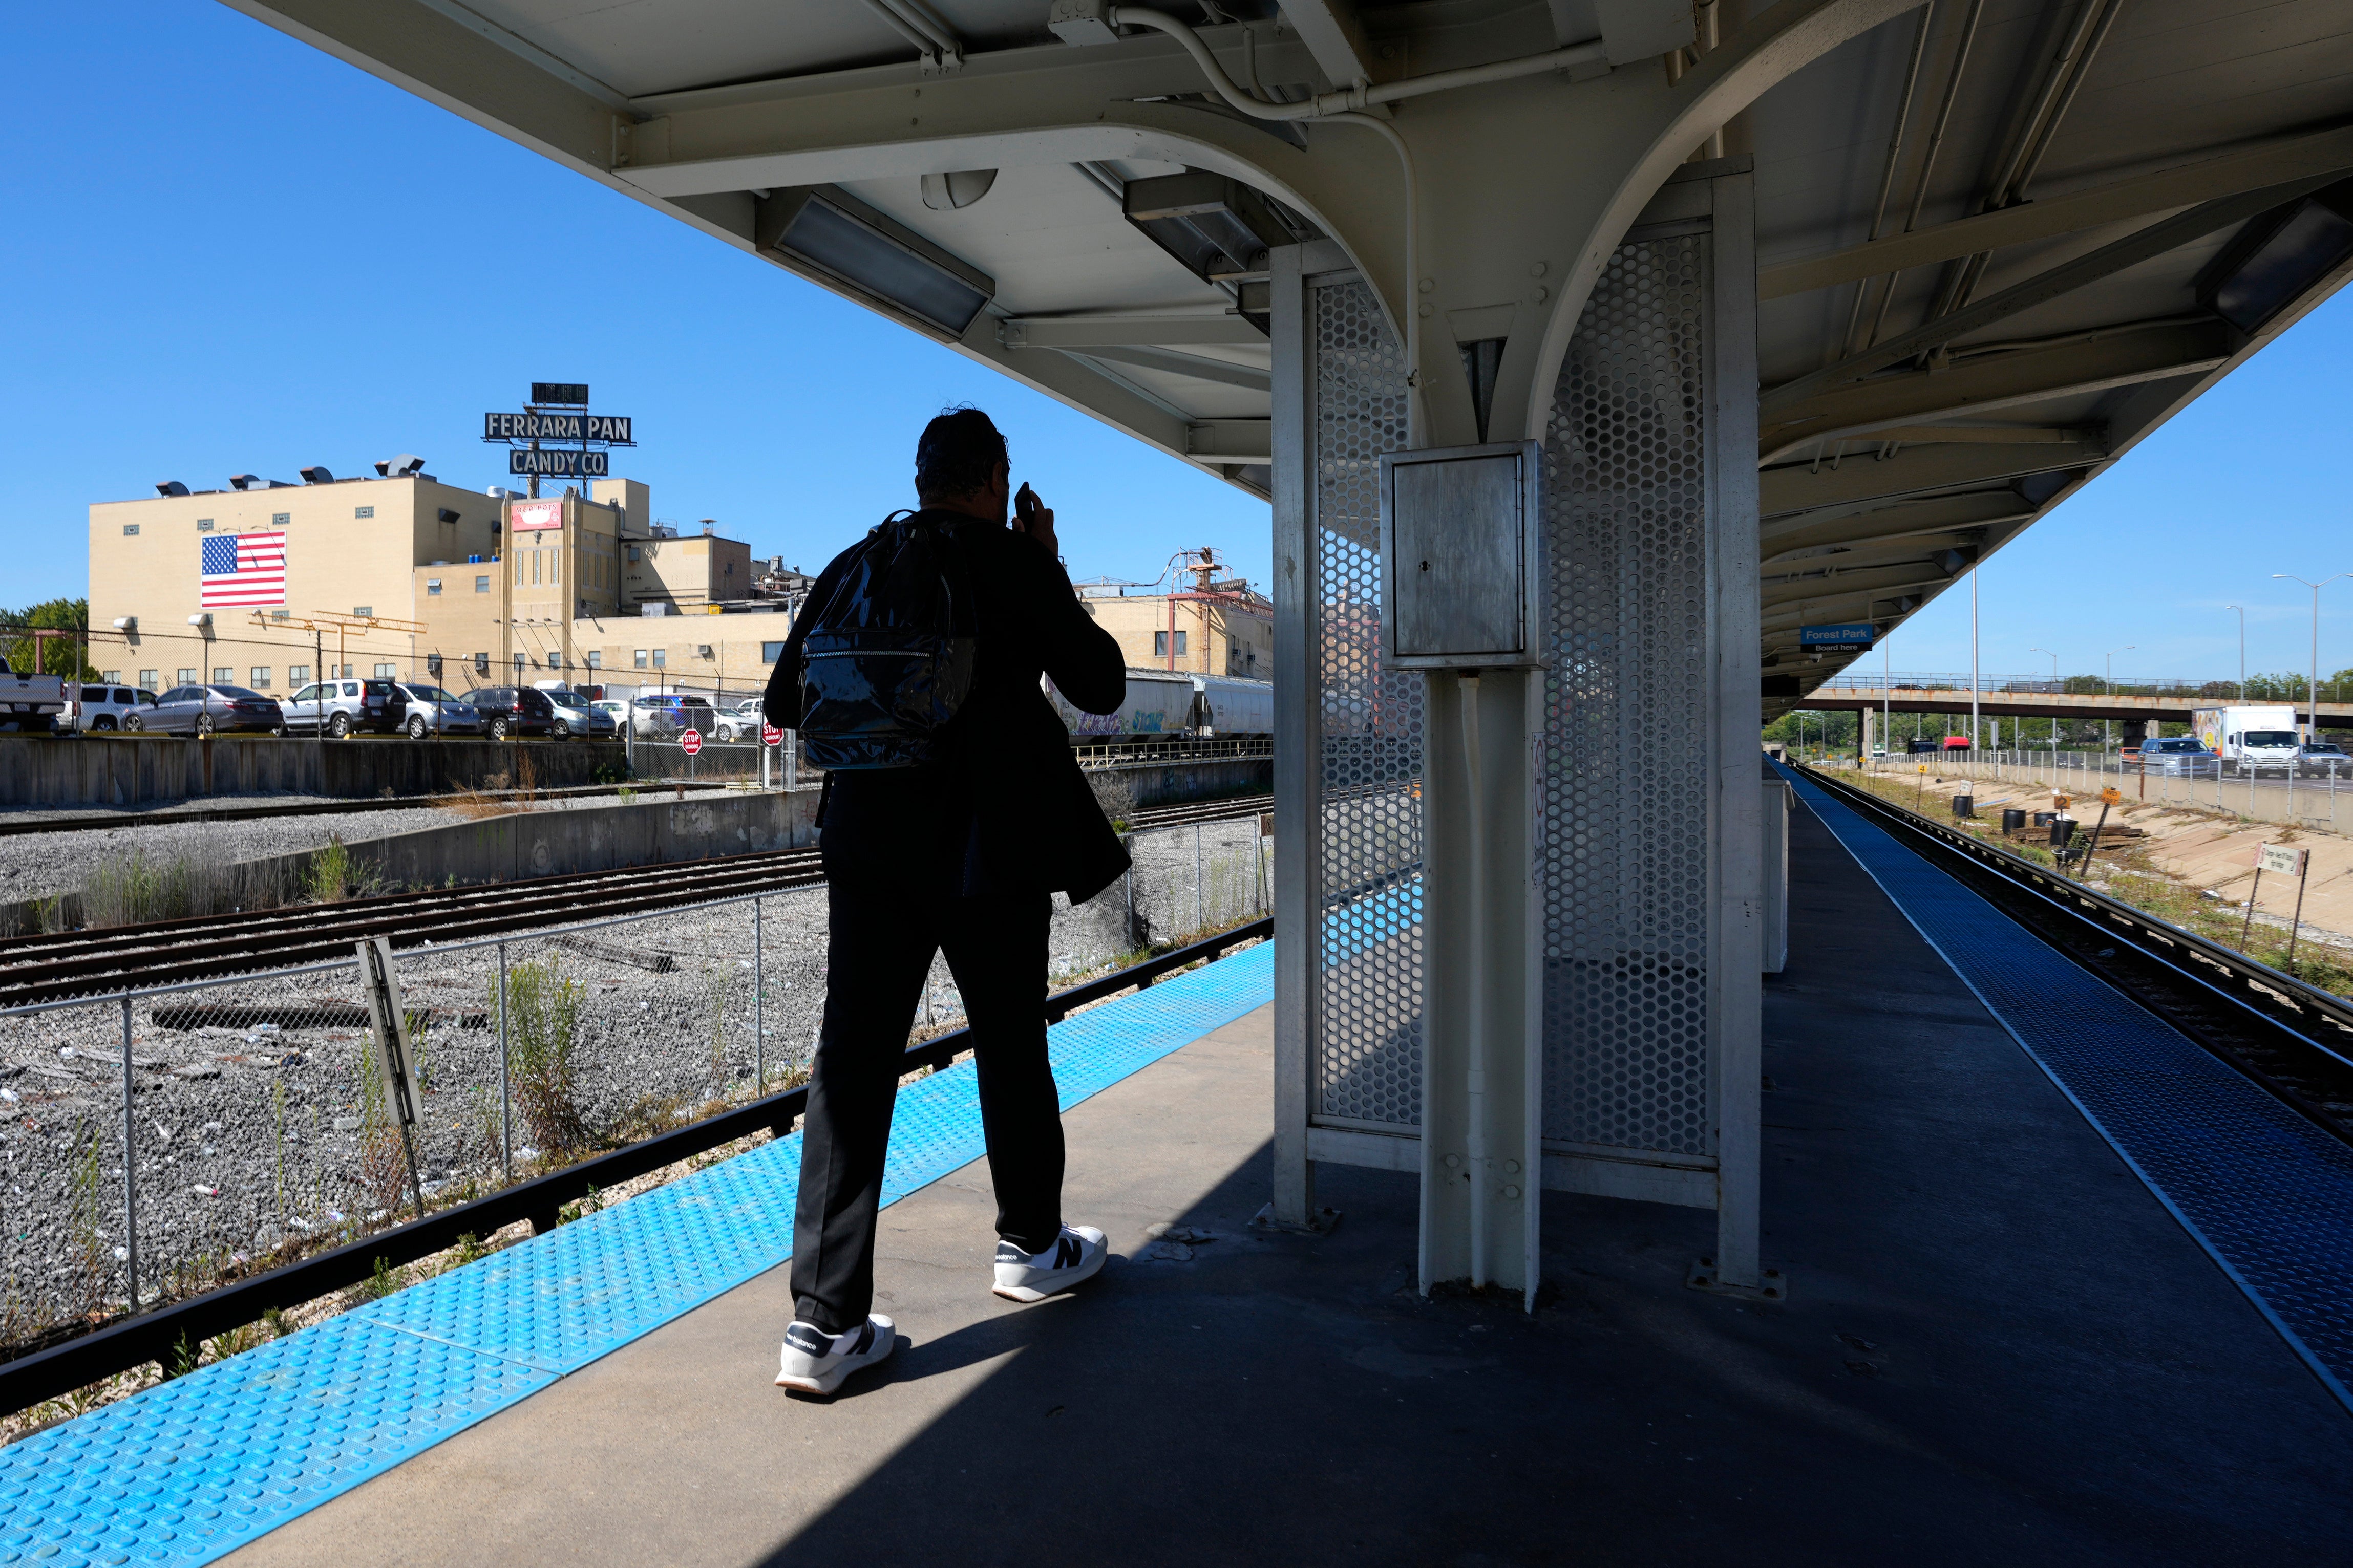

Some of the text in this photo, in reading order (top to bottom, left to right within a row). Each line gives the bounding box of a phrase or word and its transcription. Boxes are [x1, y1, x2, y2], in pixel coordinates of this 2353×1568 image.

[488, 414, 627, 440] FERRARA PAN
[513, 451, 606, 474] CANDY CO.
[1806, 629, 1867, 639] Forest Park
[684, 734, 699, 743] STOP
[2058, 797, 2067, 808] 2
[1052, 1237, 1082, 1270] N
[792, 1335, 817, 1350] balance
